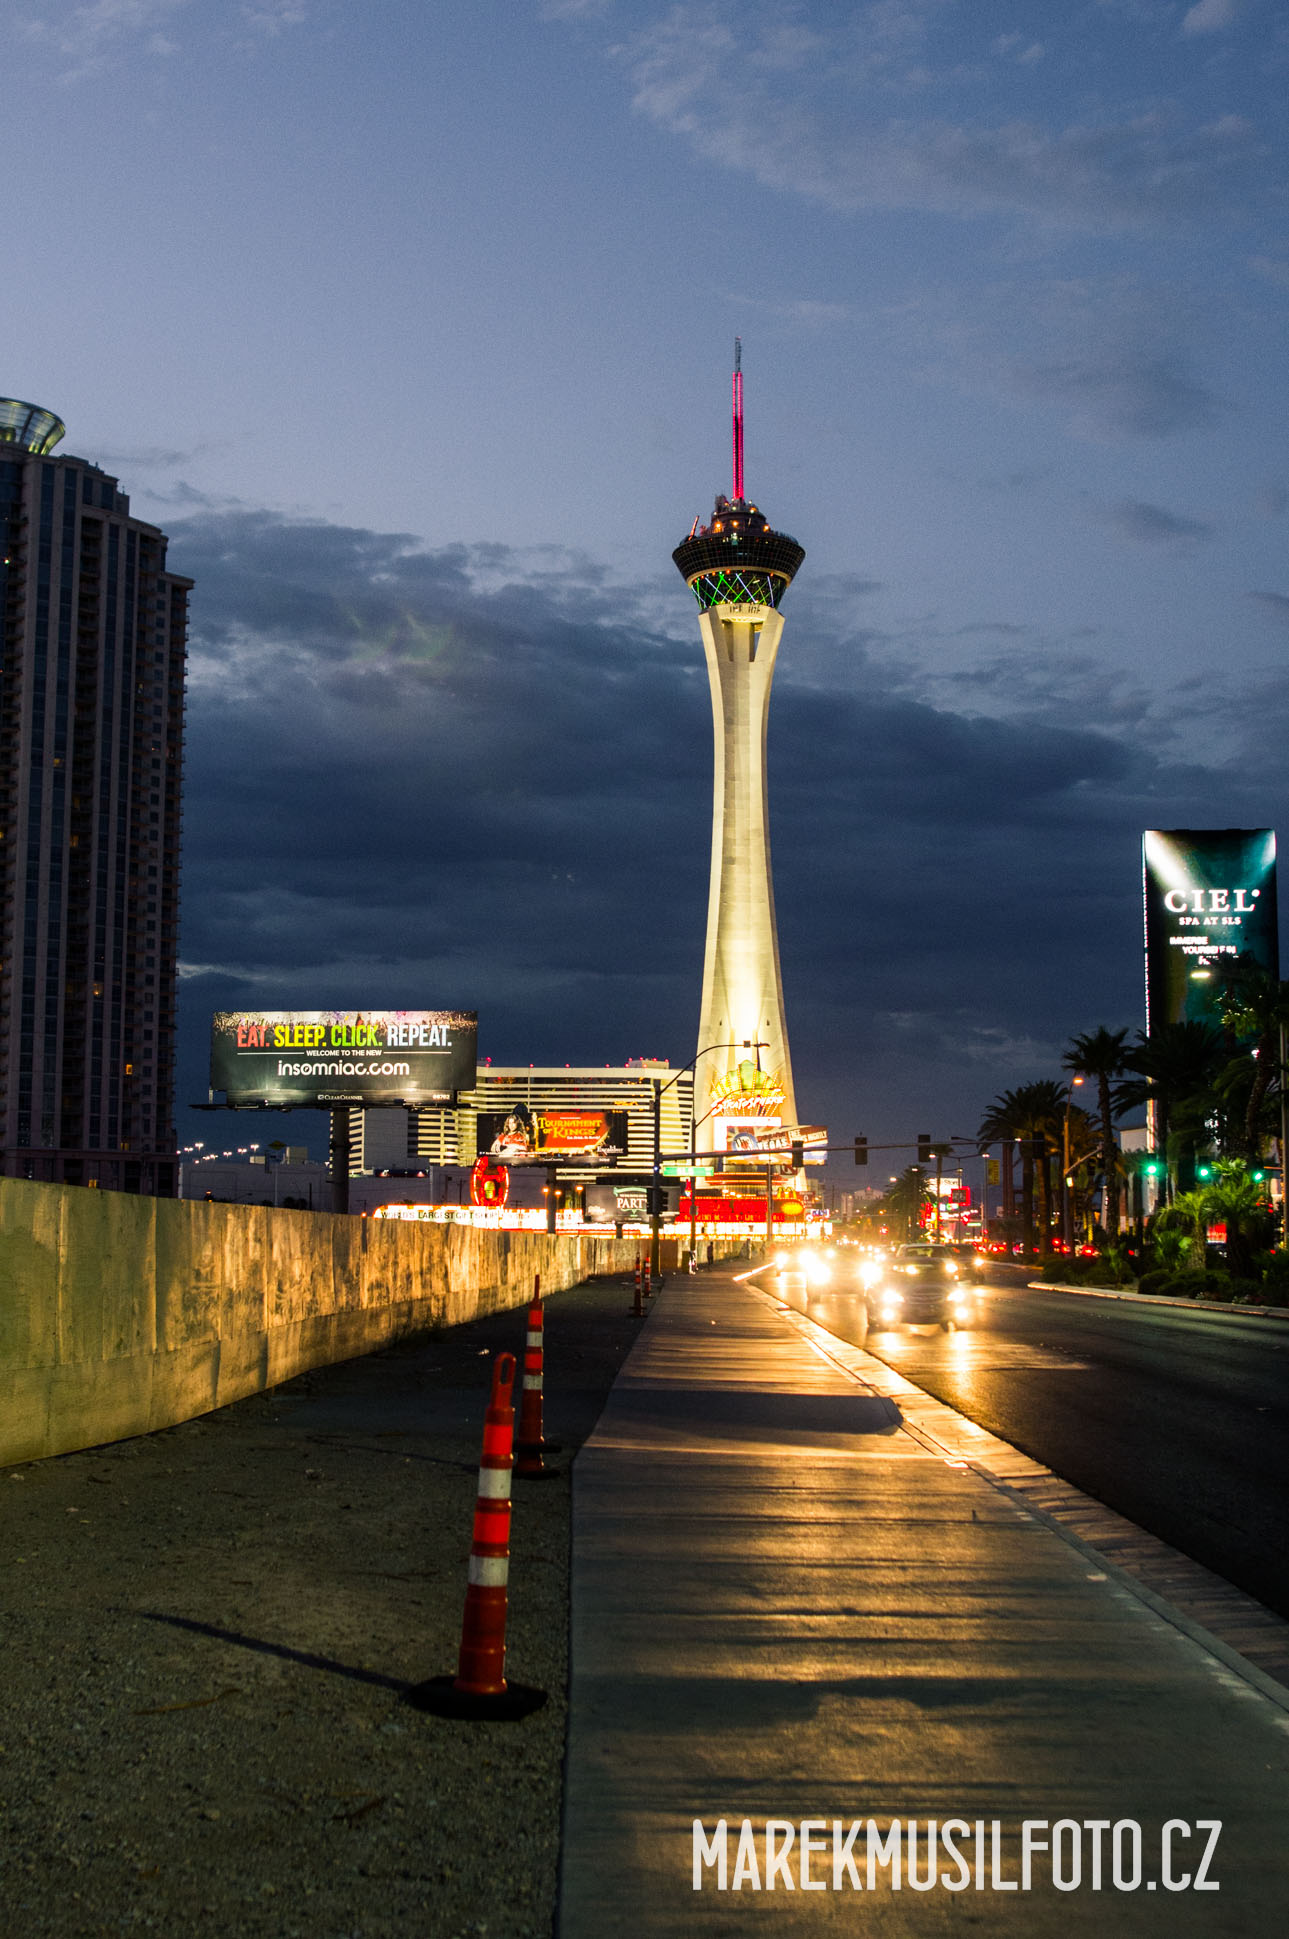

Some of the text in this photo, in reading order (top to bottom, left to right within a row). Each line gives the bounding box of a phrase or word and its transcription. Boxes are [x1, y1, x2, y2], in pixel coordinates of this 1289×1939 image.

[1179, 917, 1242, 925] SPA AT SLS
[237, 1024, 453, 1048] EAT. SLEEP. CLICK. REPEAT.
[278, 1060, 410, 1076] insomniac.com
[538, 1117, 602, 1129] TOURNAMENT
[553, 1127, 597, 1138] KINGS
[758, 1138, 787, 1150] VEGAS
